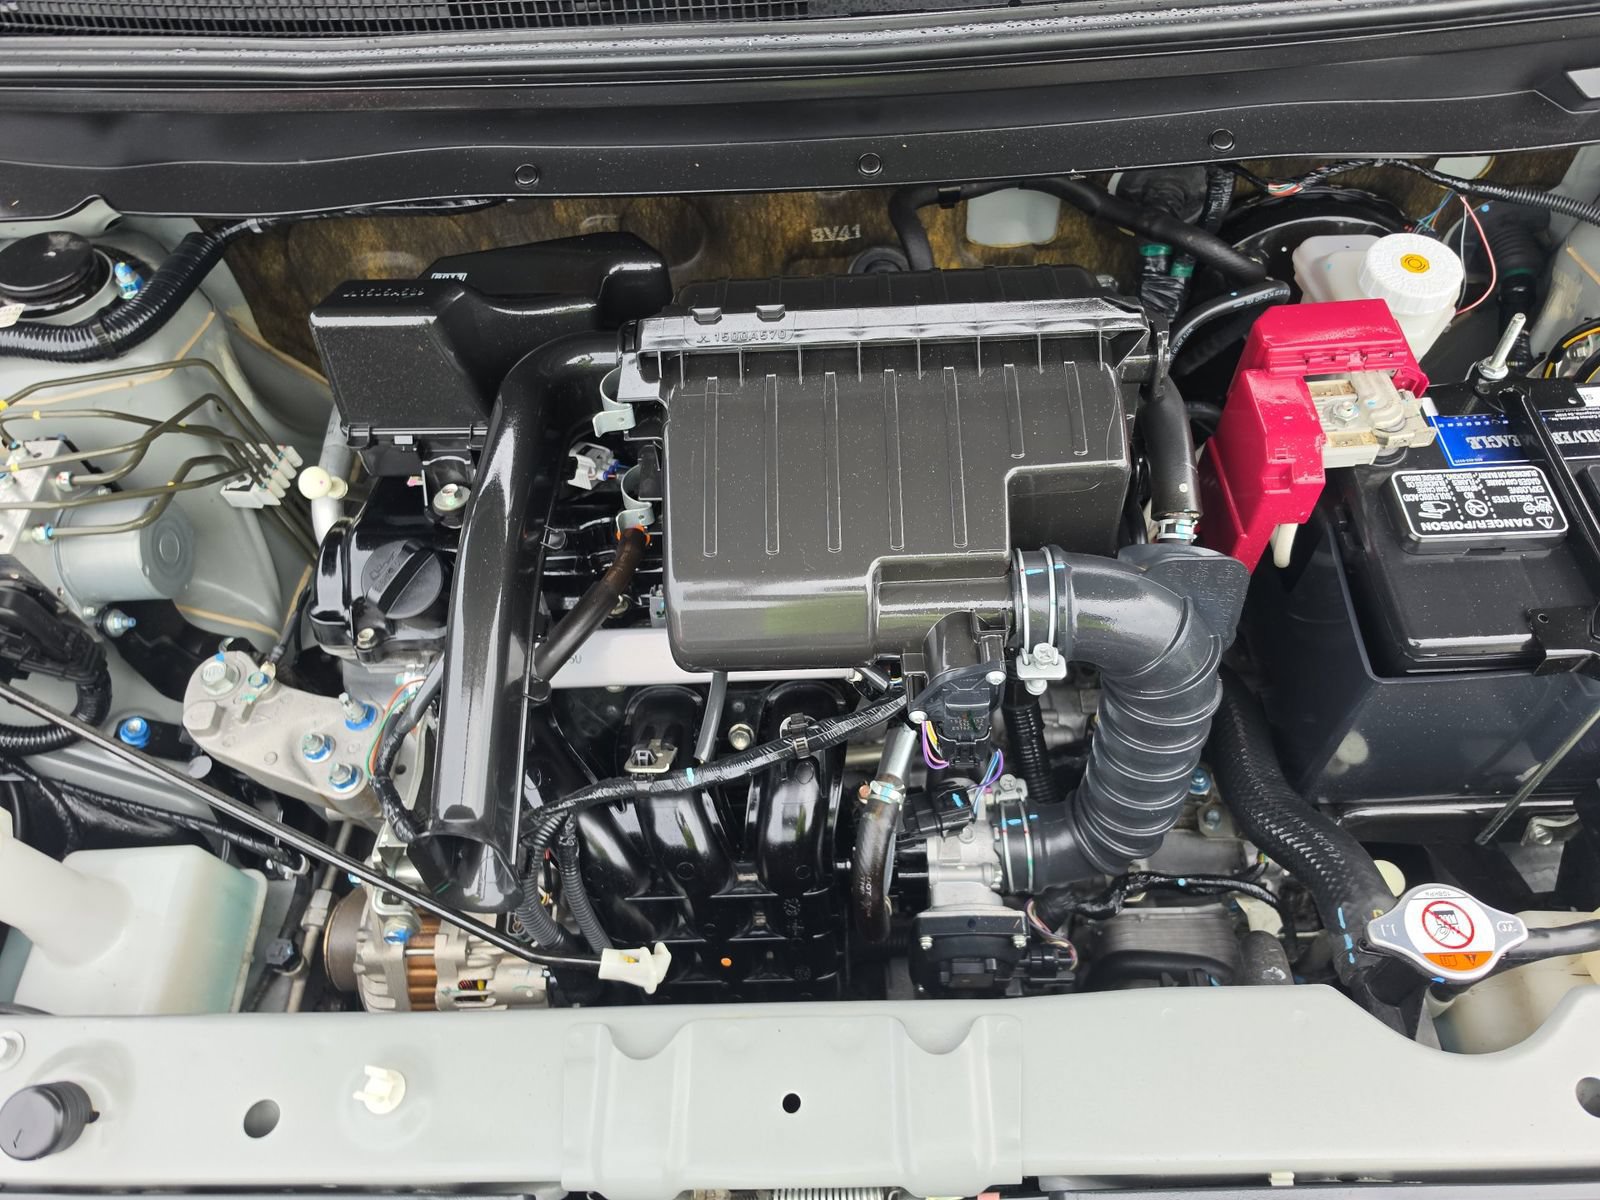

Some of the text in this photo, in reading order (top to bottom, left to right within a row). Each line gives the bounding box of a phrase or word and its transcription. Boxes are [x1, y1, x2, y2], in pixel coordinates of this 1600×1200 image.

[714, 329, 787, 343] 1500A570
[1465, 434, 1522, 450] EAGLE
[1507, 485, 1545, 494] EXPLOSIVE
[1419, 492, 1452, 501] SULFURIC
[1491, 495, 1510, 504] EYES
[1420, 518, 1534, 531] DANGER/POISON
